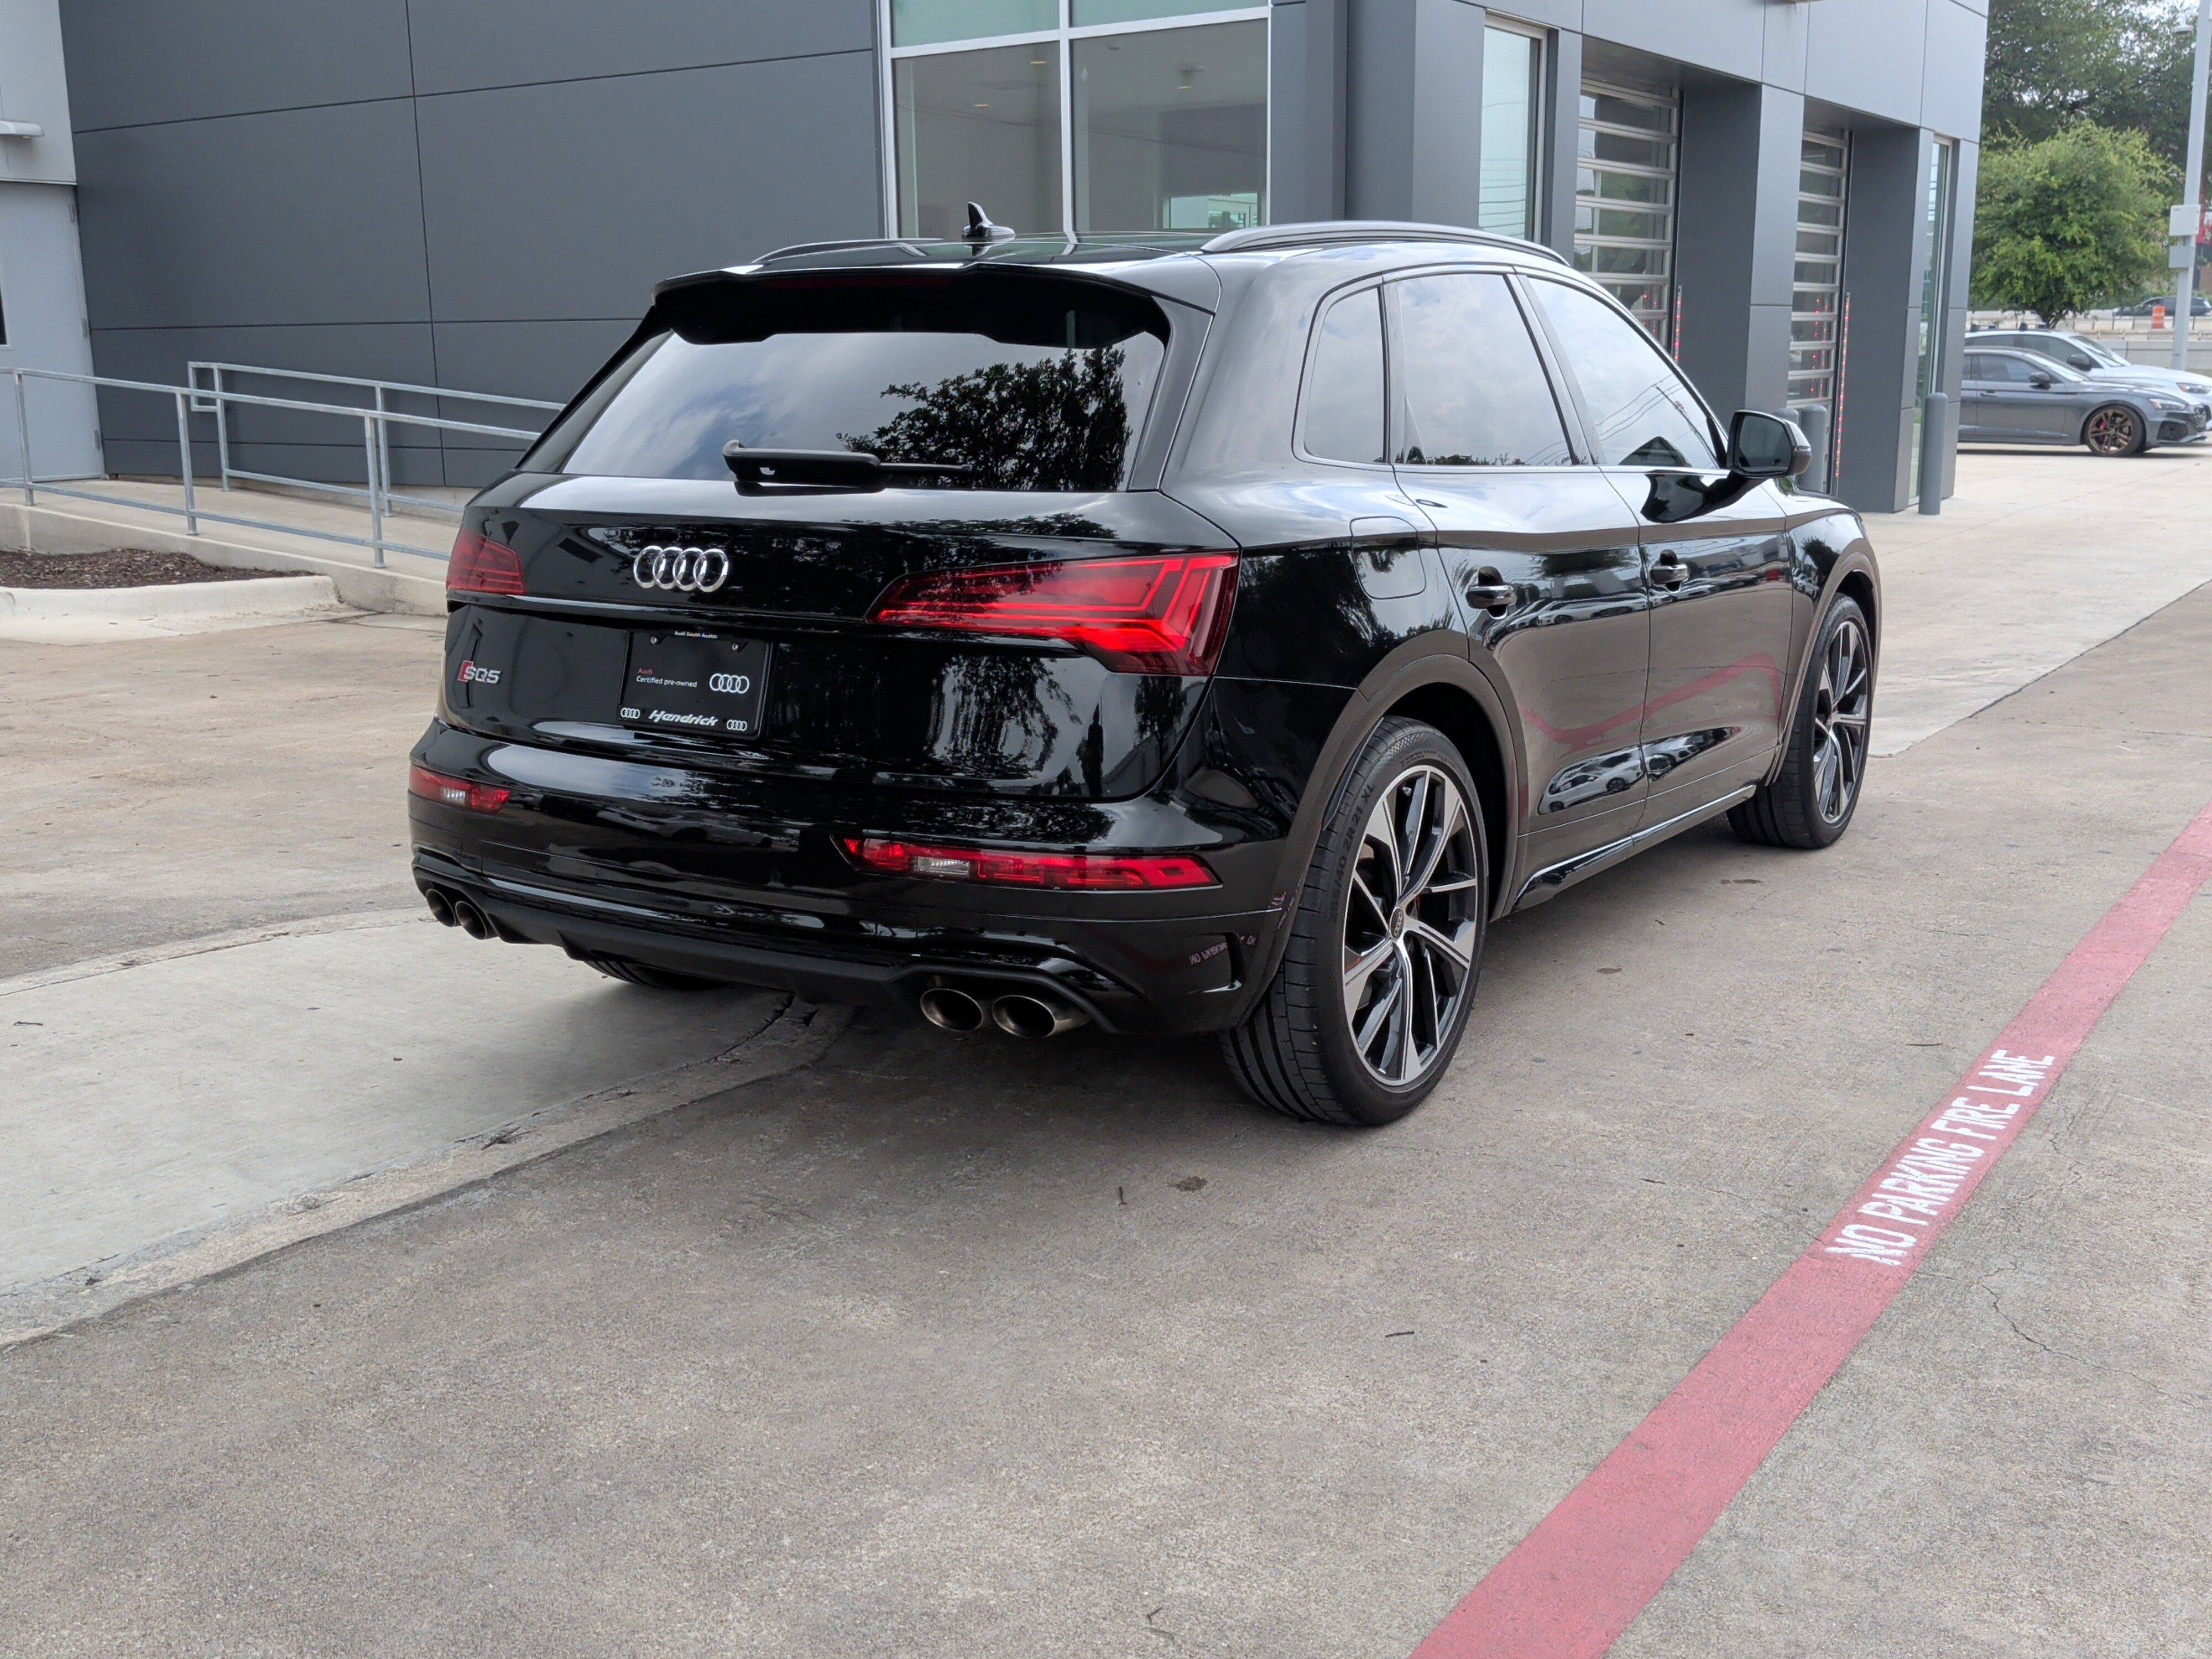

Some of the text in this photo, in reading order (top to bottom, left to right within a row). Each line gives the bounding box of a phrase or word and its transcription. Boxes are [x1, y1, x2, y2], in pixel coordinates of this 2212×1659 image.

[463, 666, 501, 684] SQ5
[636, 675, 663, 685] Certified
[648, 709, 718, 726] Hendrick
[1361, 784, 1375, 804] XL
[1824, 1049, 2056, 1266] NO PARKING FIRE LANE
